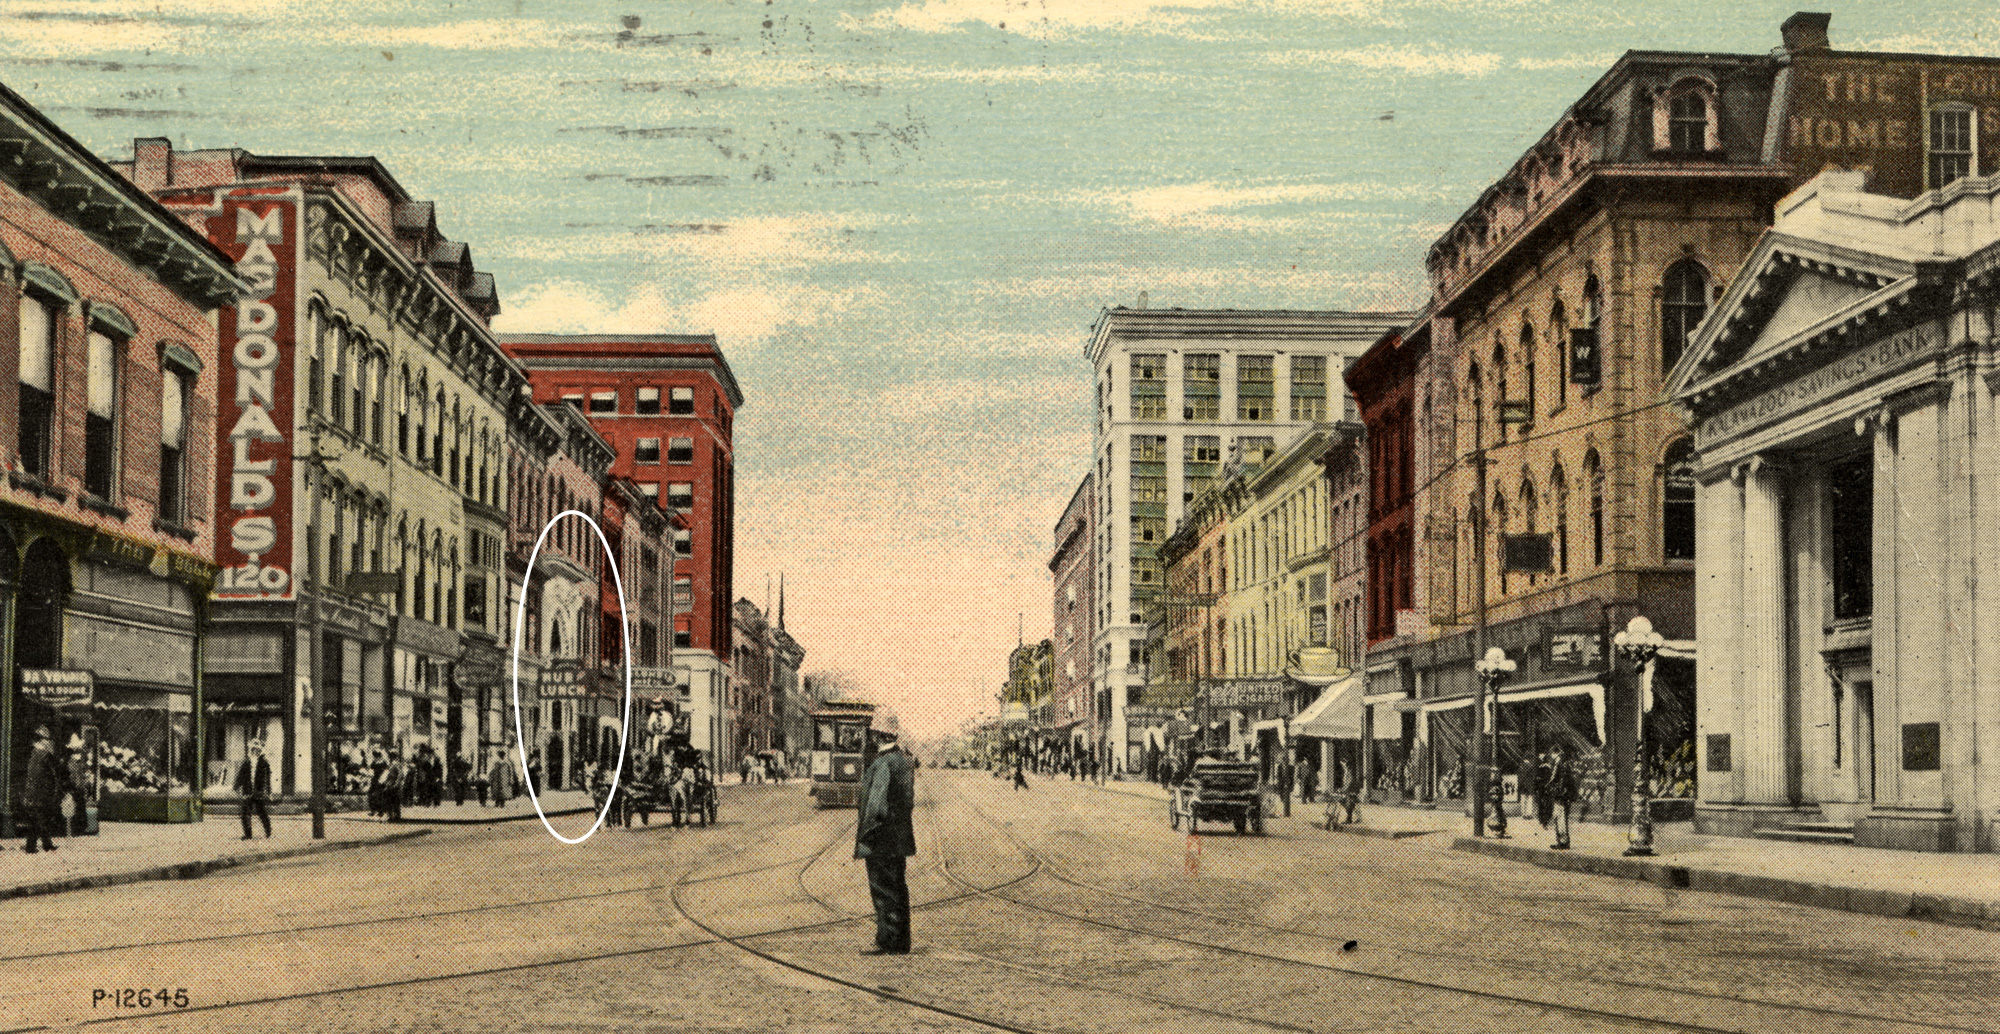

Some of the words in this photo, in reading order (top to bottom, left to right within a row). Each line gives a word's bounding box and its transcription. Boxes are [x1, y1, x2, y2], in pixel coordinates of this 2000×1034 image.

[1822, 72, 1896, 102] THE
[1789, 117, 1907, 149] HOME
[1706, 392, 1788, 438] KALAMAZOO
[1798, 354, 1868, 402] SAVINGS
[1878, 330, 1931, 367] BANK
[218, 565, 289, 592] 120
[540, 684, 586, 696] LUNCH
[1238, 682, 1280, 693] UNITED
